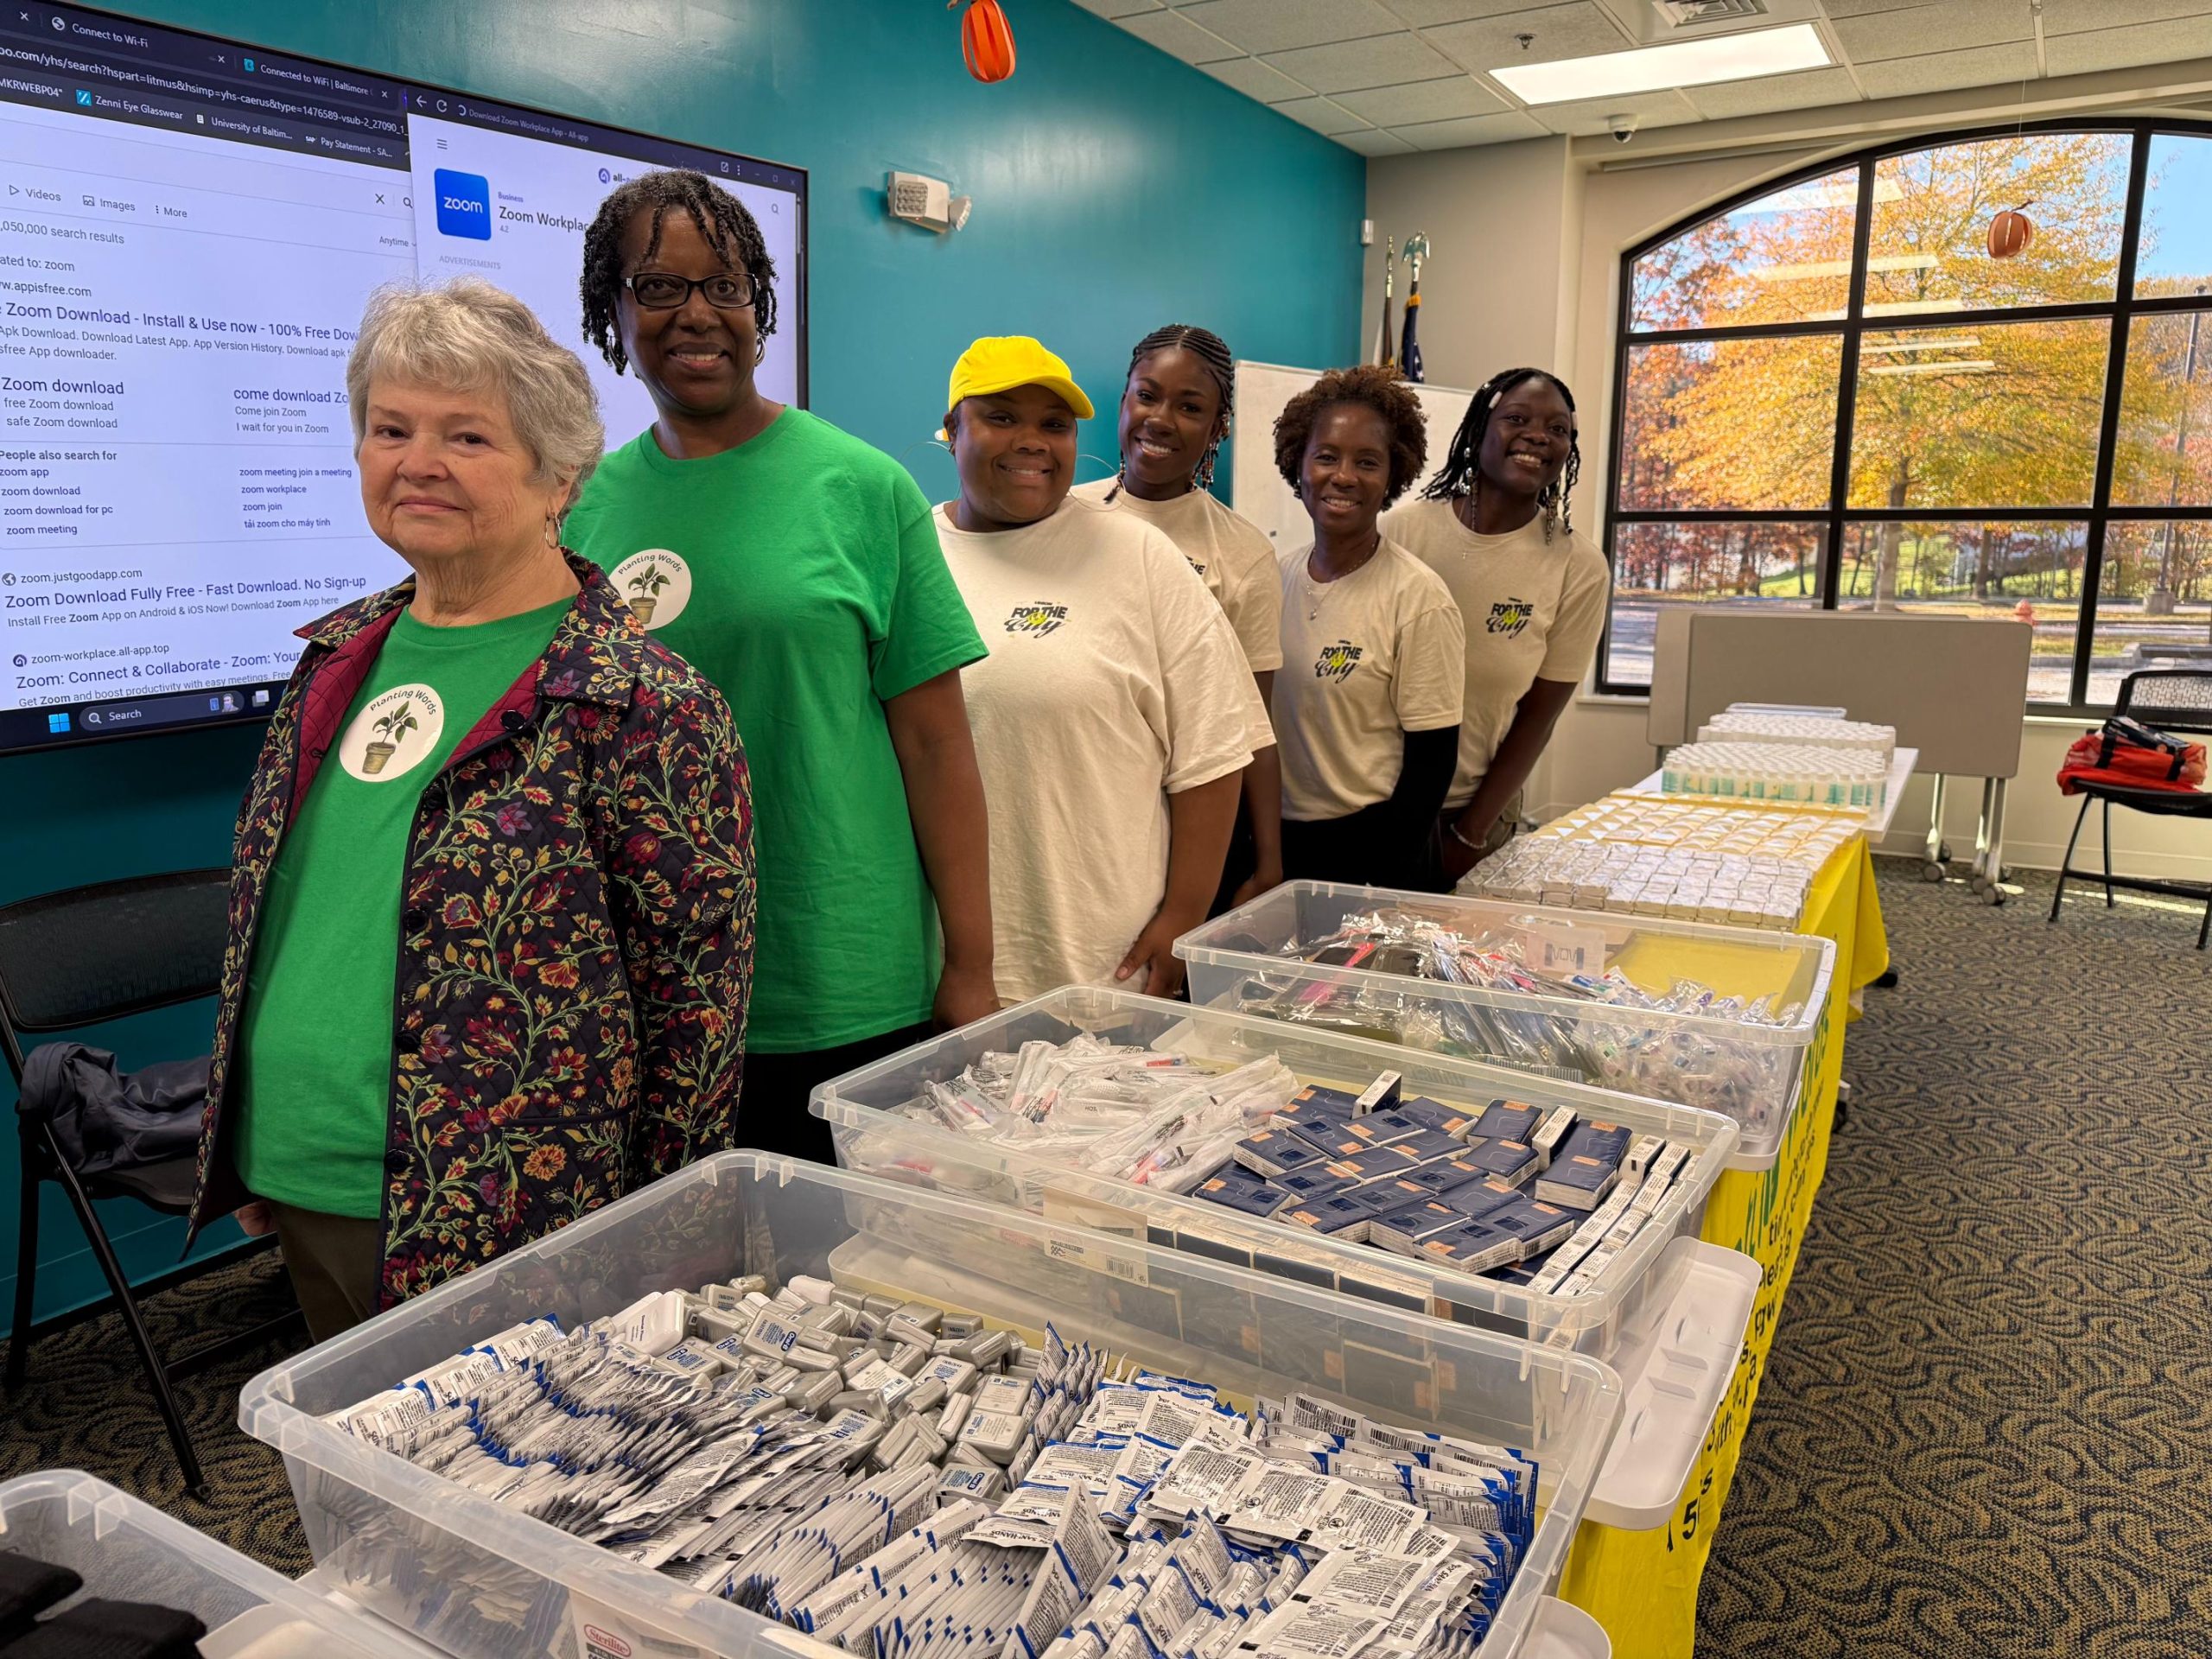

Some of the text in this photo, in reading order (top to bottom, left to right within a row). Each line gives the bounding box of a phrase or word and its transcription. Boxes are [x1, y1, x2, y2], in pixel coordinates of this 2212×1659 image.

[73, 23, 149, 48] Connect to Wi-Fi
[261, 64, 369, 96] Connected to WiFi Baltimore
[95, 95, 183, 120] Zenni Eye Glasswear
[212, 117, 292, 140] University of Baltim...
[468, 109, 590, 143] Download Zoom Workplace App All-app
[321, 137, 334, 149] Pay
[335, 140, 372, 155] Statement
[25, 188, 61, 201] Videos
[498, 191, 524, 203] Business
[99, 198, 136, 212] Images
[443, 196, 483, 213] zoom
[164, 207, 188, 218] More
[499, 206, 534, 224] Zoom
[50, 226, 87, 240] search
[89, 232, 124, 245] results
[379, 236, 410, 248] Anytime
[27, 258, 41, 270] to:
[45, 261, 75, 272] zoom
[439, 255, 501, 270] ADVERTISEMENTS
[6, 302, 330, 340] Zoom Download Install & Use now 100% Free
[0, 325, 346, 359] Apk Download. Download Latest App. App Version History. Download apk
[29, 346, 50, 359] App
[54, 346, 117, 360] downloader.
[1, 377, 124, 395] Zoom download
[233, 389, 331, 404] come download
[3, 397, 114, 411] free Zoom download
[235, 406, 307, 418] Come join Zoom
[7, 416, 118, 429] safe Zoom download
[242, 423, 328, 434] wait for you in Zoom
[0, 450, 118, 462] People also search for
[30, 468, 49, 479] app
[264, 468, 297, 478] meeting
[298, 468, 313, 478] join
[321, 467, 352, 478] meeting
[33, 486, 81, 496] download
[266, 485, 307, 494] workplace
[3, 505, 113, 516] zoom download for pc
[267, 502, 283, 512] join
[6, 524, 78, 536] zoom meeting
[298, 518, 315, 529] máy
[618, 554, 682, 575] Planting Words
[21, 569, 143, 583] zoom.justgoodapp.com
[5, 576, 366, 608] Zoom Download Fully Free Fast Download. No Sign-up
[8, 596, 340, 627] Install Free Zoom App on Android & iOS Now! Download Zoom App here
[1011, 606, 1068, 619] FOR THE
[1491, 603, 1534, 616] FOR THE
[31, 643, 169, 664] zoom-workplace.all-app.top
[1319, 645, 1363, 660] FOR THE
[16, 652, 301, 689] Zoom: Connect & Collaborate Zoom: Your
[18, 671, 291, 708] Get Zoom and boost productivity with easy meetings. Free
[370, 690, 436, 715] Planting Words
[108, 708, 142, 721] Search
[588, 1628, 627, 1654] Sterilite
